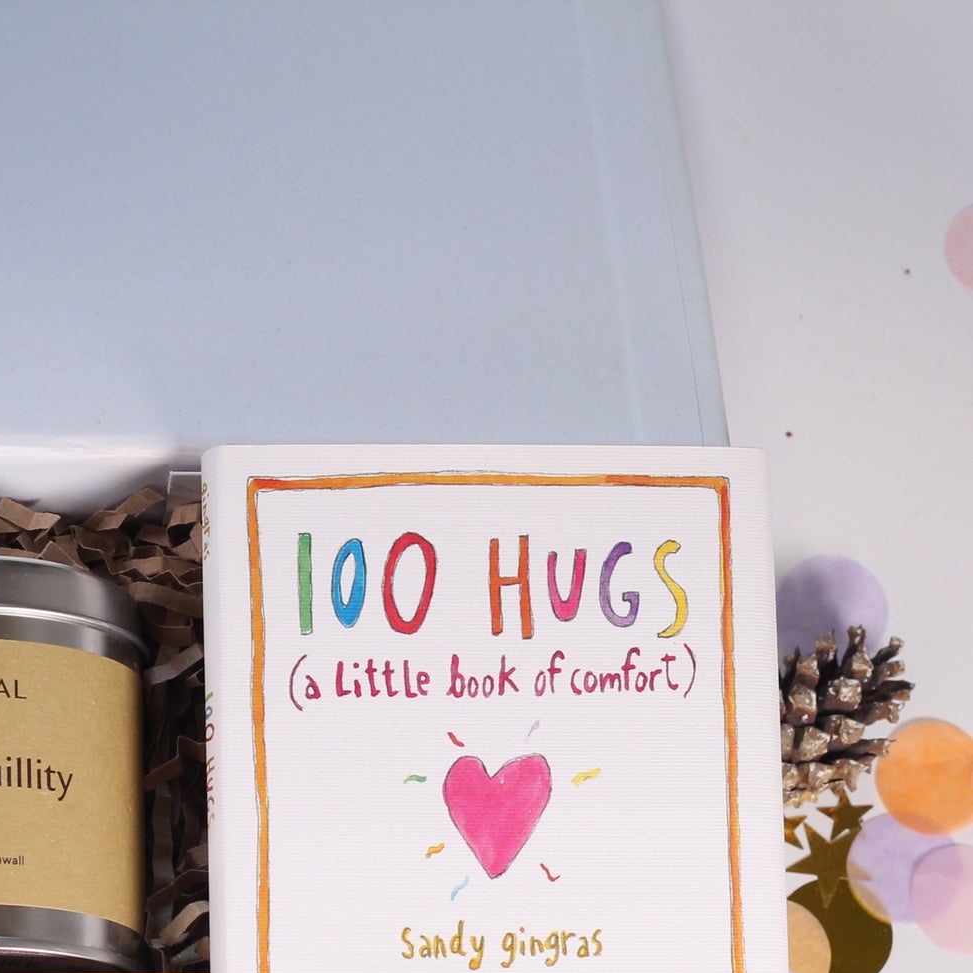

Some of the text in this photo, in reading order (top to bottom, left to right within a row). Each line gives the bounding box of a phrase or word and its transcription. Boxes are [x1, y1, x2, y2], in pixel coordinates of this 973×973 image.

[297, 532, 688, 640] 100 HUGS
[446, 654, 520, 698] book
[534, 650, 565, 696] of
[570, 644, 697, 698] comfort)
[500, 928, 603, 967] gingras
